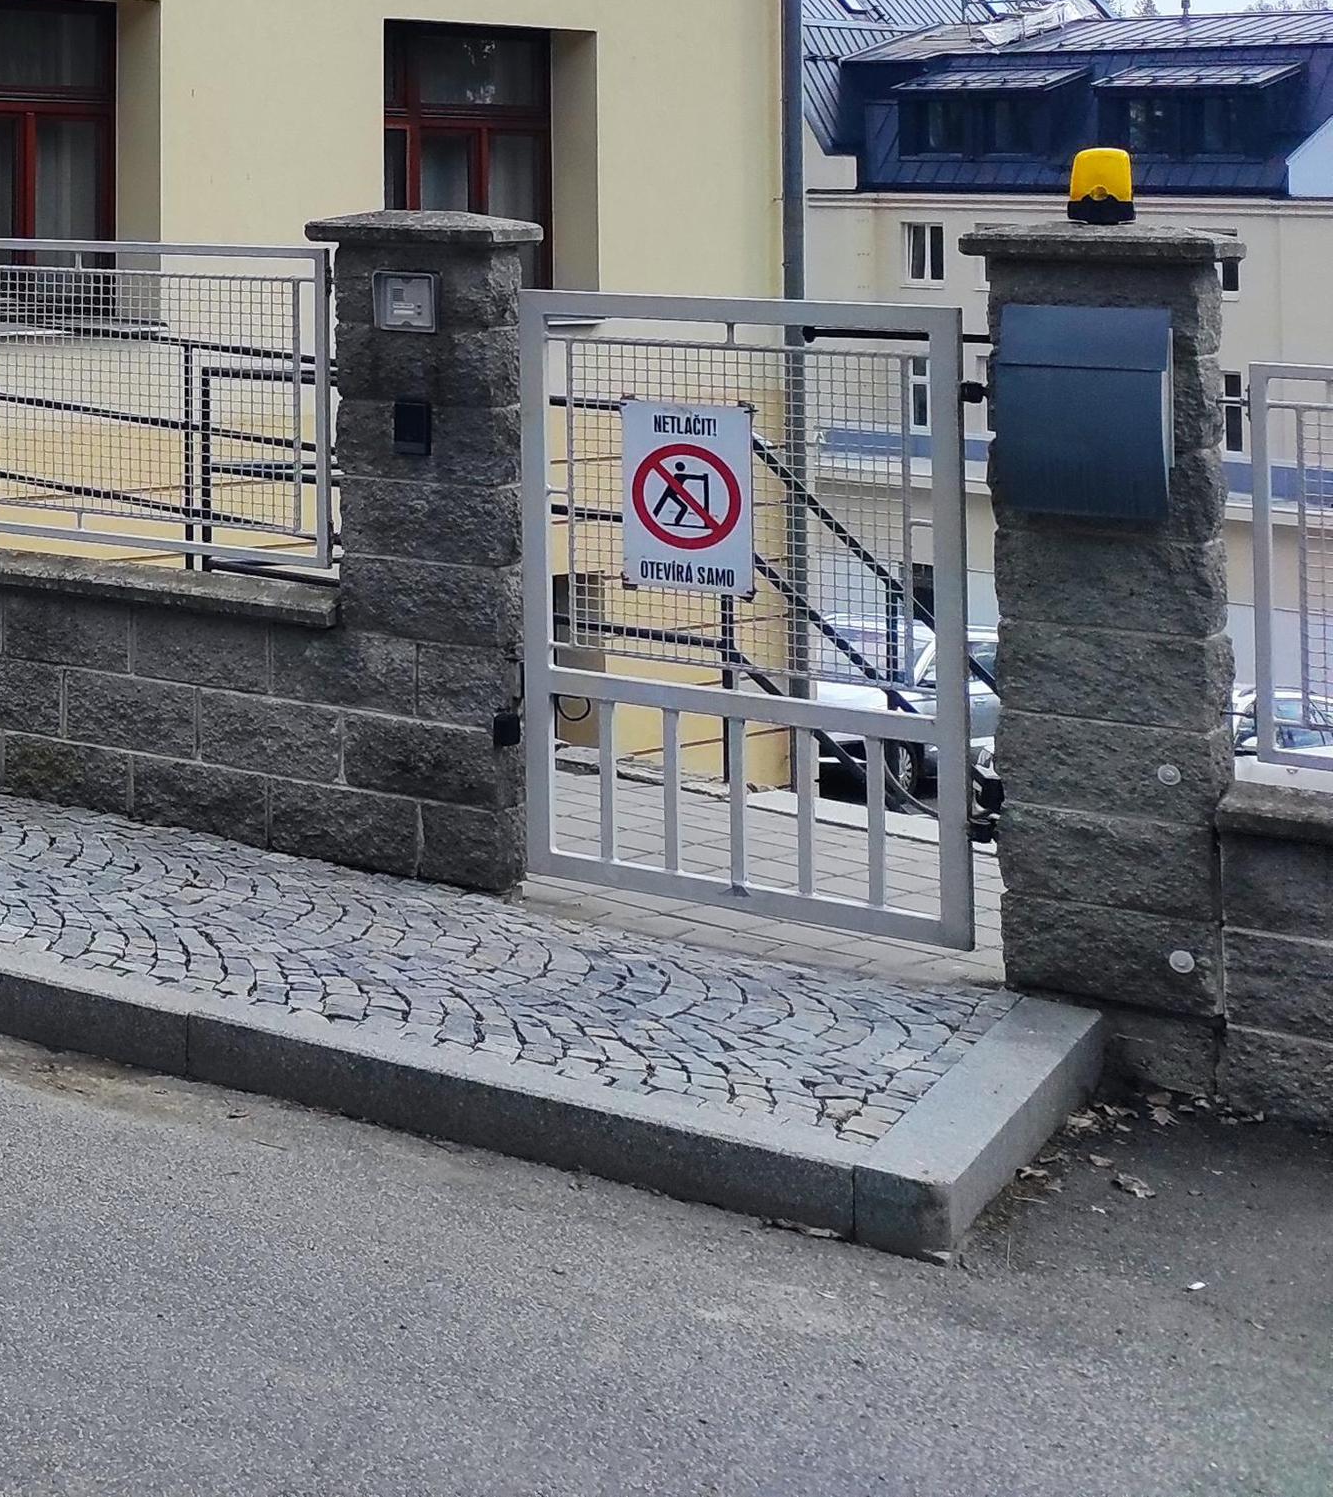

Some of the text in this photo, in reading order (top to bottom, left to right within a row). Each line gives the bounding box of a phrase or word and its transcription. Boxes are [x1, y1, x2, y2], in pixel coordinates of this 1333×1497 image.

[653, 414, 717, 437] NETLAČIT!
[640, 560, 734, 587] OTEVÍRÁ SAMO
